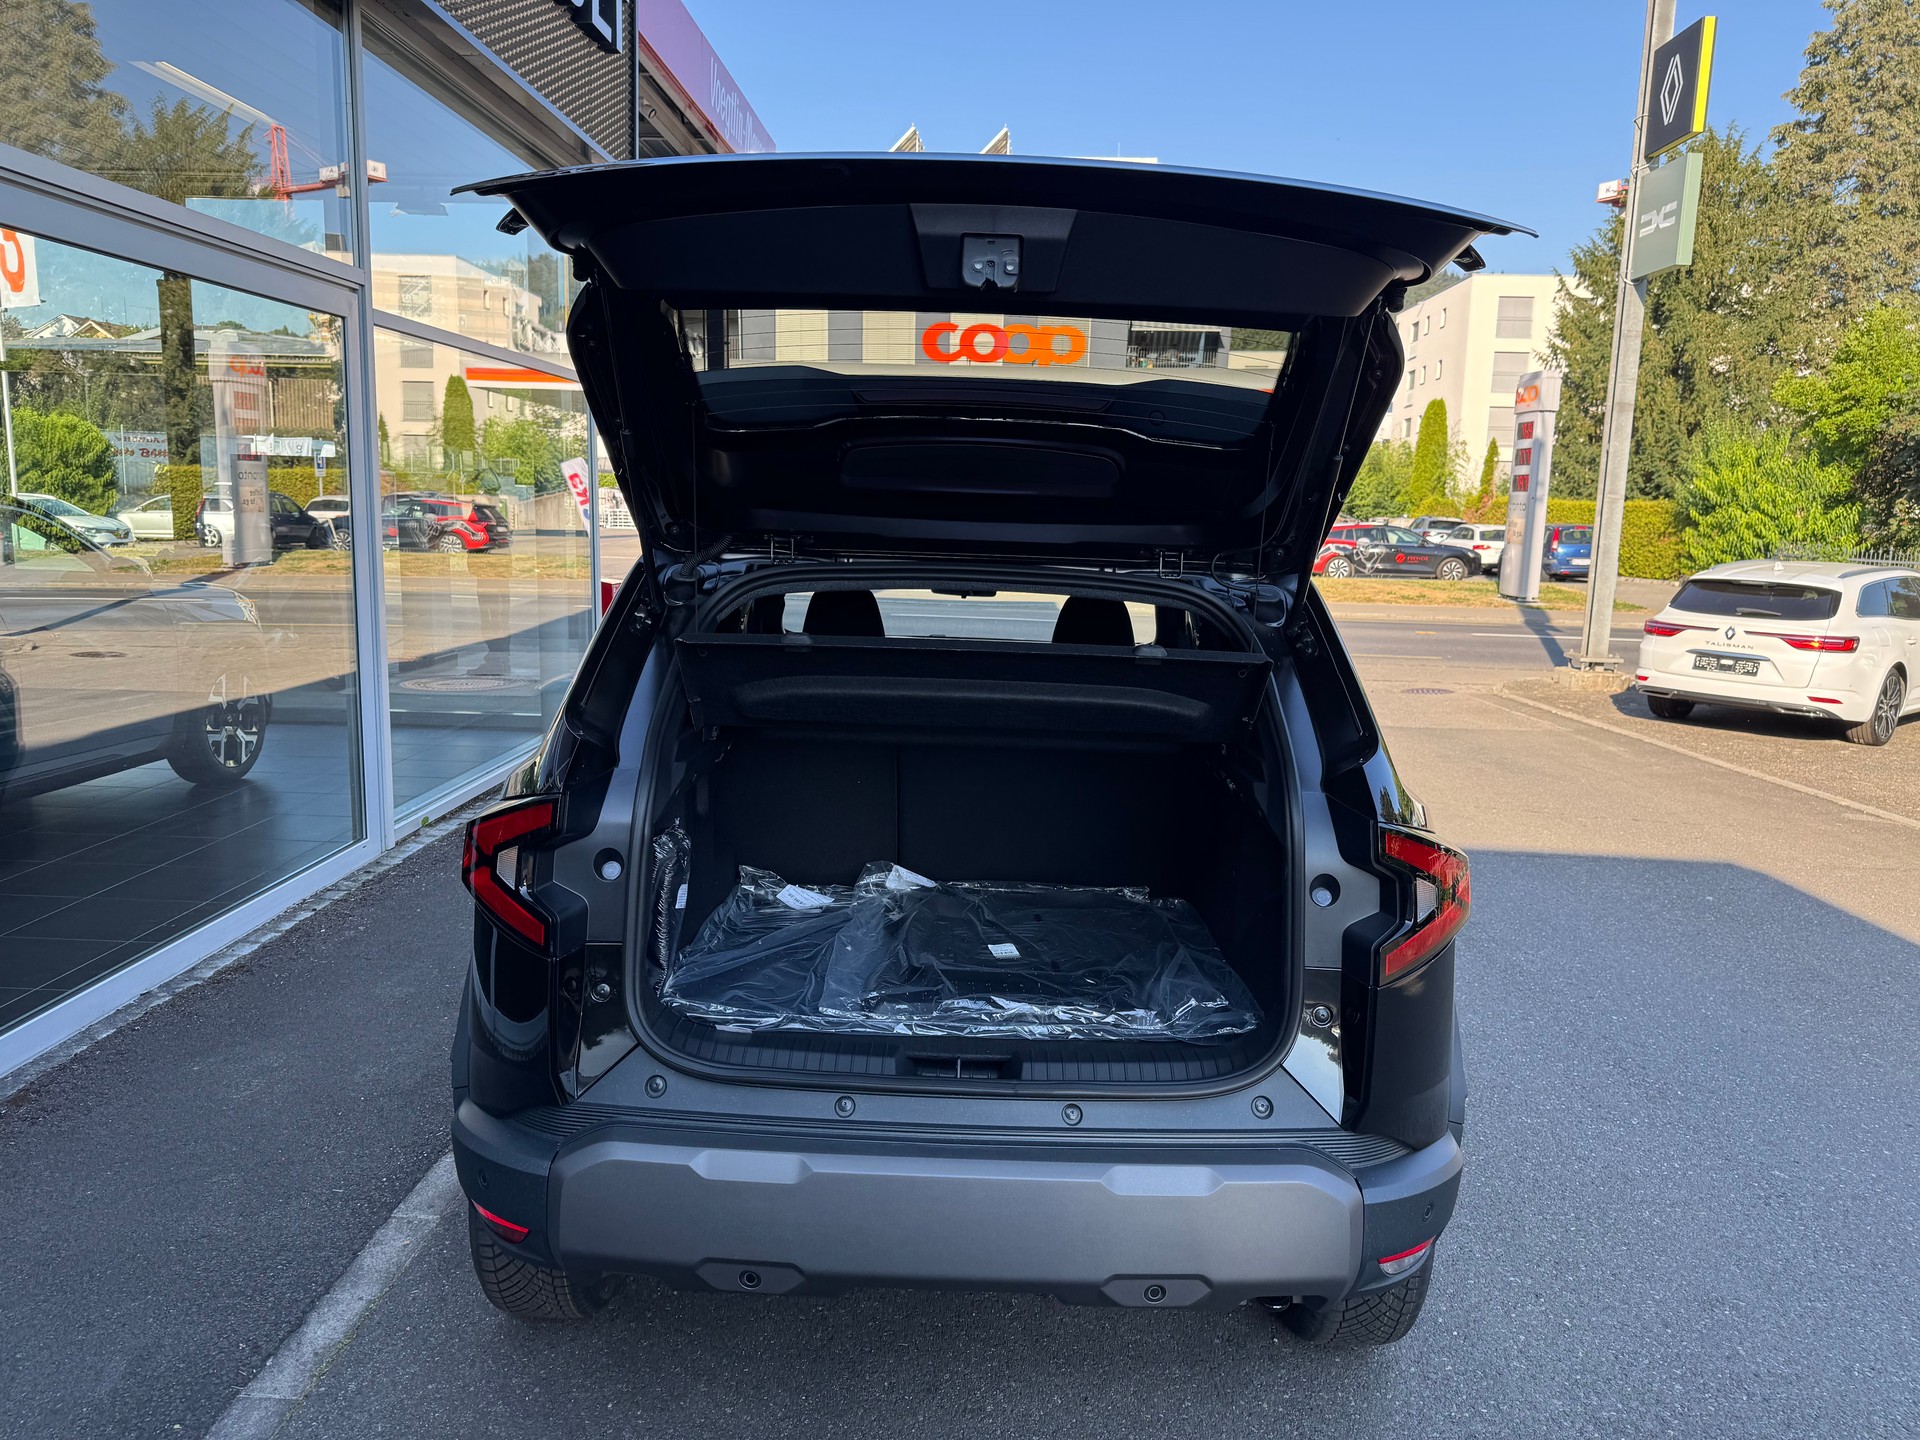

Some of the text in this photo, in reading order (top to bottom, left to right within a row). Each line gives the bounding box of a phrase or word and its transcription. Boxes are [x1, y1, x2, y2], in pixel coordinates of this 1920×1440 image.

[711, 57, 763, 152] Voegtlin-M
[922, 322, 1086, 367] coop
[1705, 641, 1754, 650] TALISMAN
